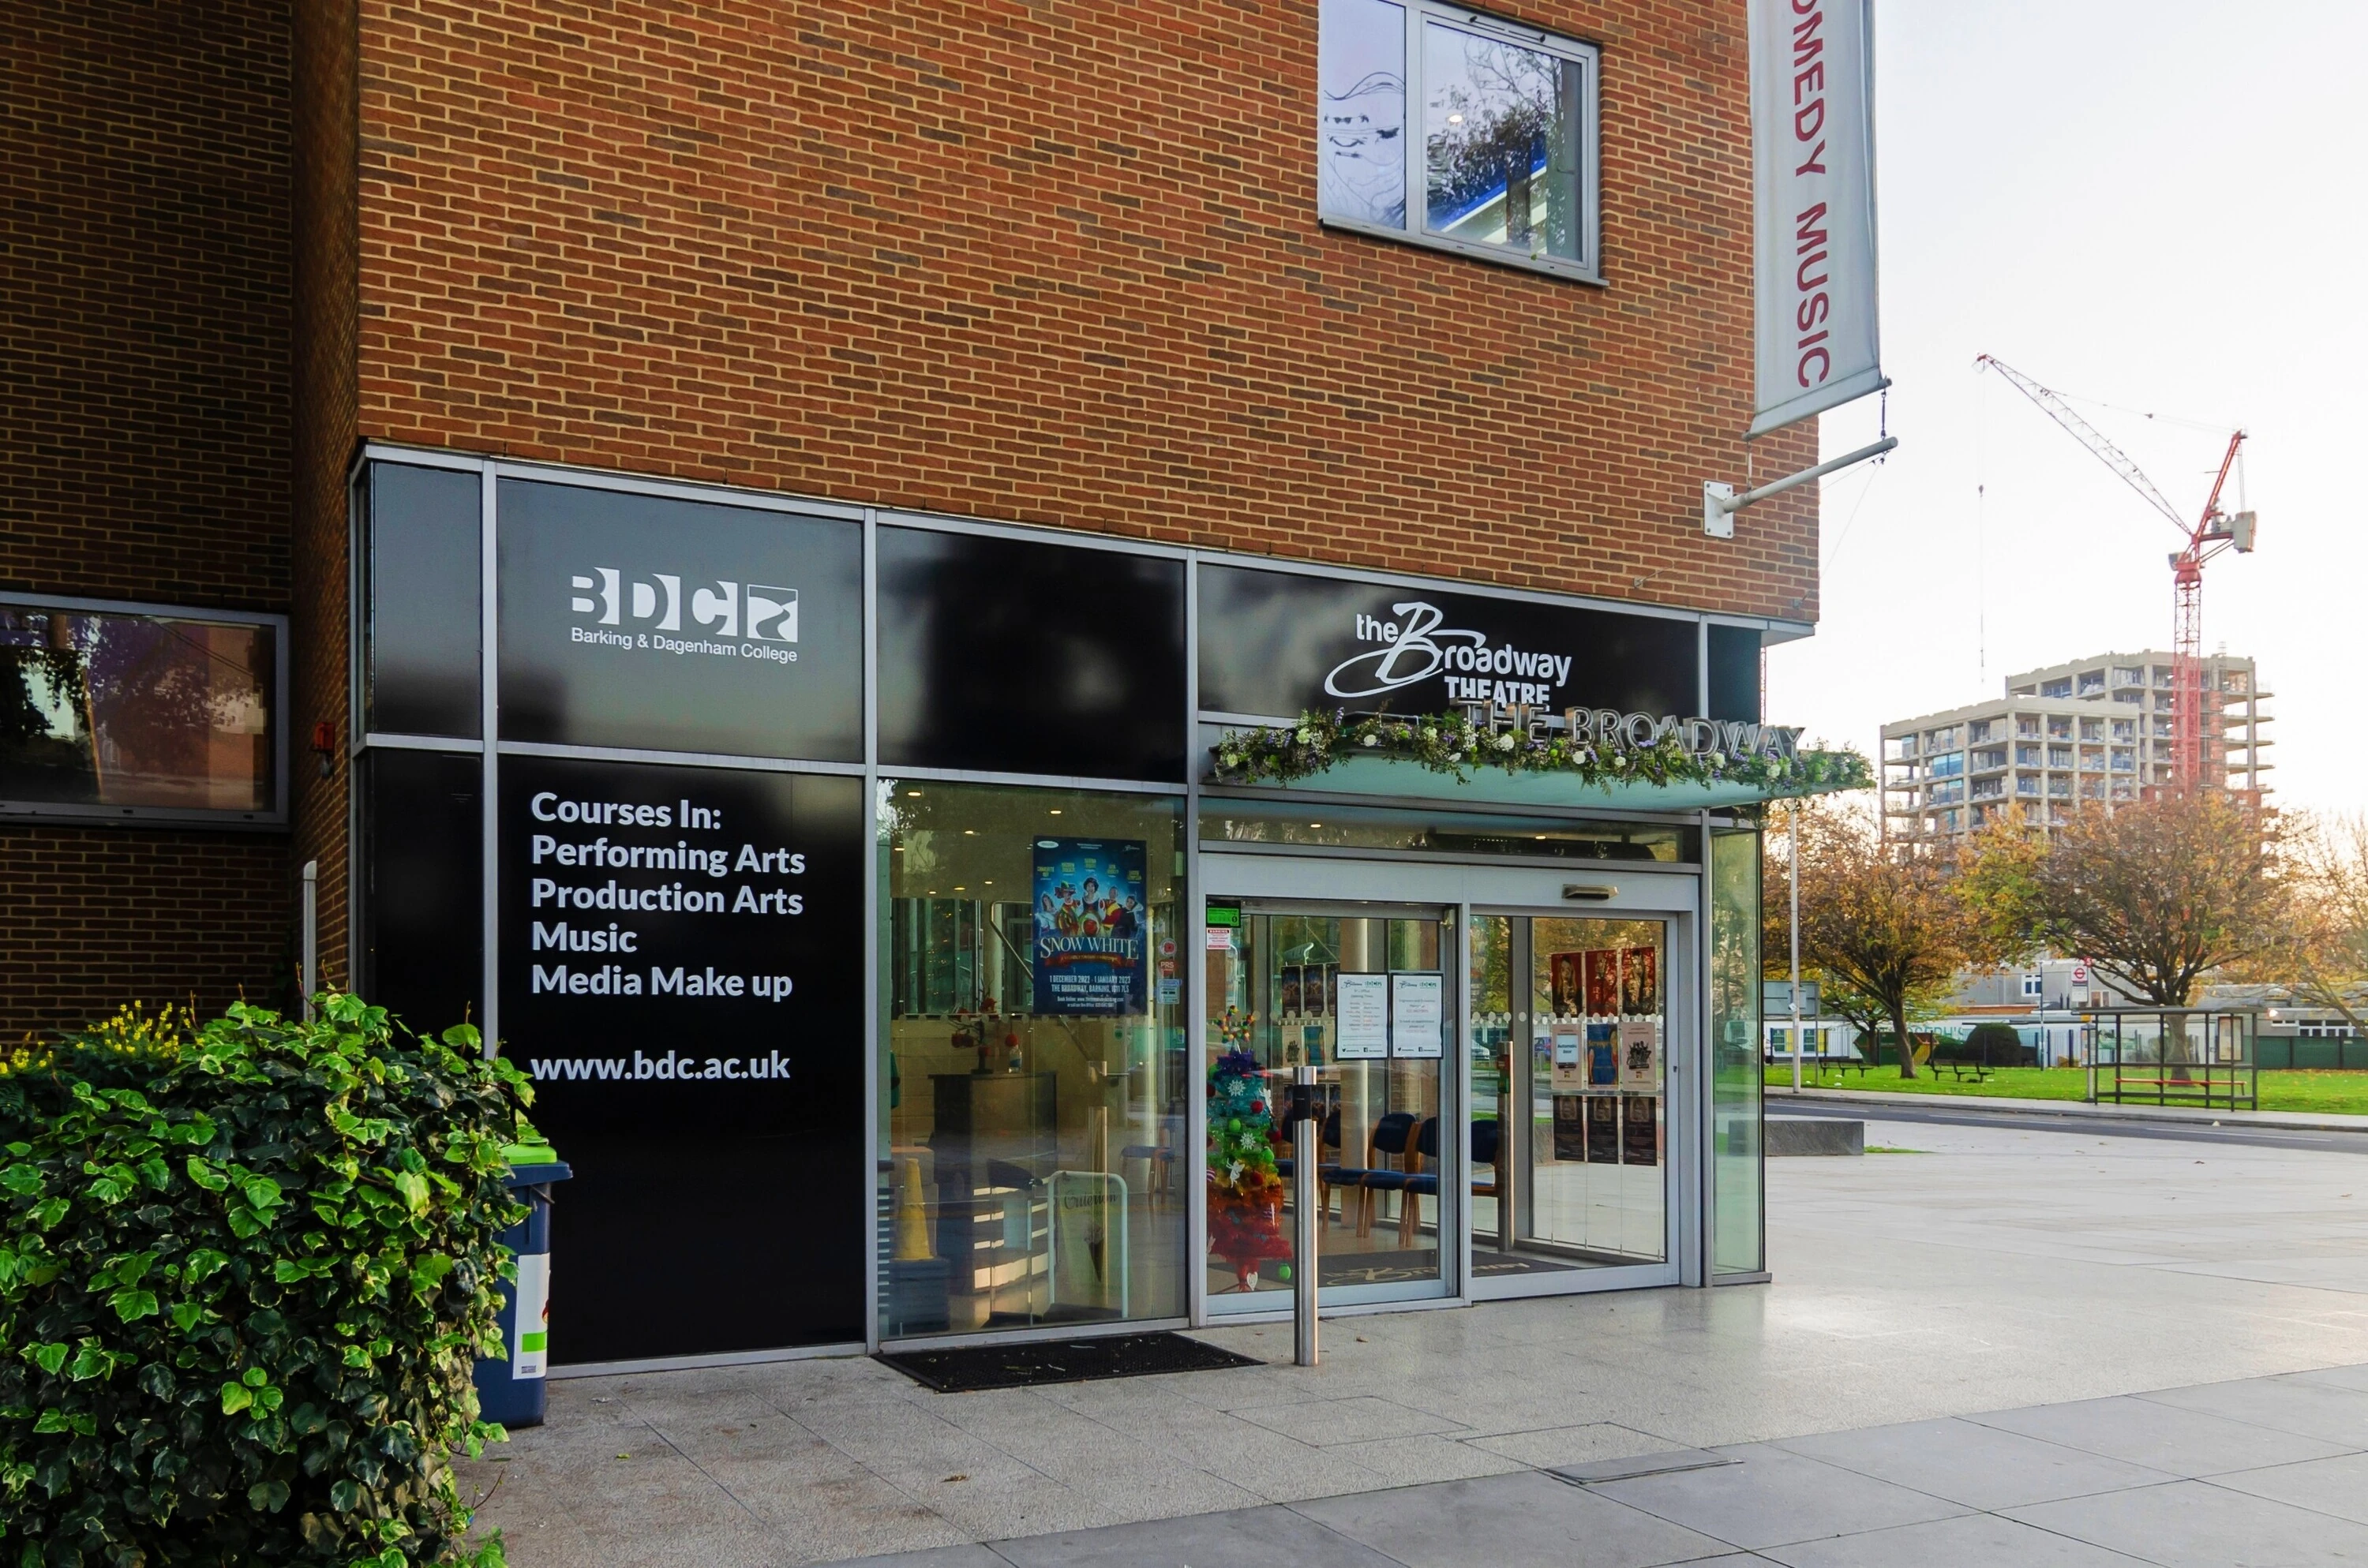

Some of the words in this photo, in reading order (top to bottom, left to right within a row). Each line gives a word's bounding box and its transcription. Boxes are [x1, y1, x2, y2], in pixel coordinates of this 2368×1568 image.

[1797, 201, 1830, 388] MUSIC
[572, 567, 738, 636] BDC
[571, 627, 632, 649] Barking
[638, 636, 649, 649] &
[654, 634, 736, 657] Dagenham
[741, 643, 798, 664] College
[1356, 613, 1399, 643] the
[1325, 601, 1572, 698] Broadway
[1444, 675, 1550, 712] THEATRE
[1450, 696, 1550, 747] THE
[1566, 706, 1806, 761] BROADWAY
[530, 791, 672, 827] Courses
[680, 799, 721, 830] In:
[531, 834, 729, 877] Performing
[734, 844, 806, 874] Arts
[531, 878, 725, 913] Production
[732, 885, 804, 915] Arts
[531, 921, 638, 952] Music
[1040, 936, 1085, 959] SNOW
[1086, 937, 1139, 960] WHITE
[531, 964, 643, 995] Media
[650, 966, 744, 997] Make
[751, 975, 793, 1003] up
[1051, 984, 1061, 993] THE
[1097, 975, 1118, 984] JANUARY
[1118, 975, 1131, 984] 2023
[530, 1050, 791, 1080] www.bdc.ac.uk
